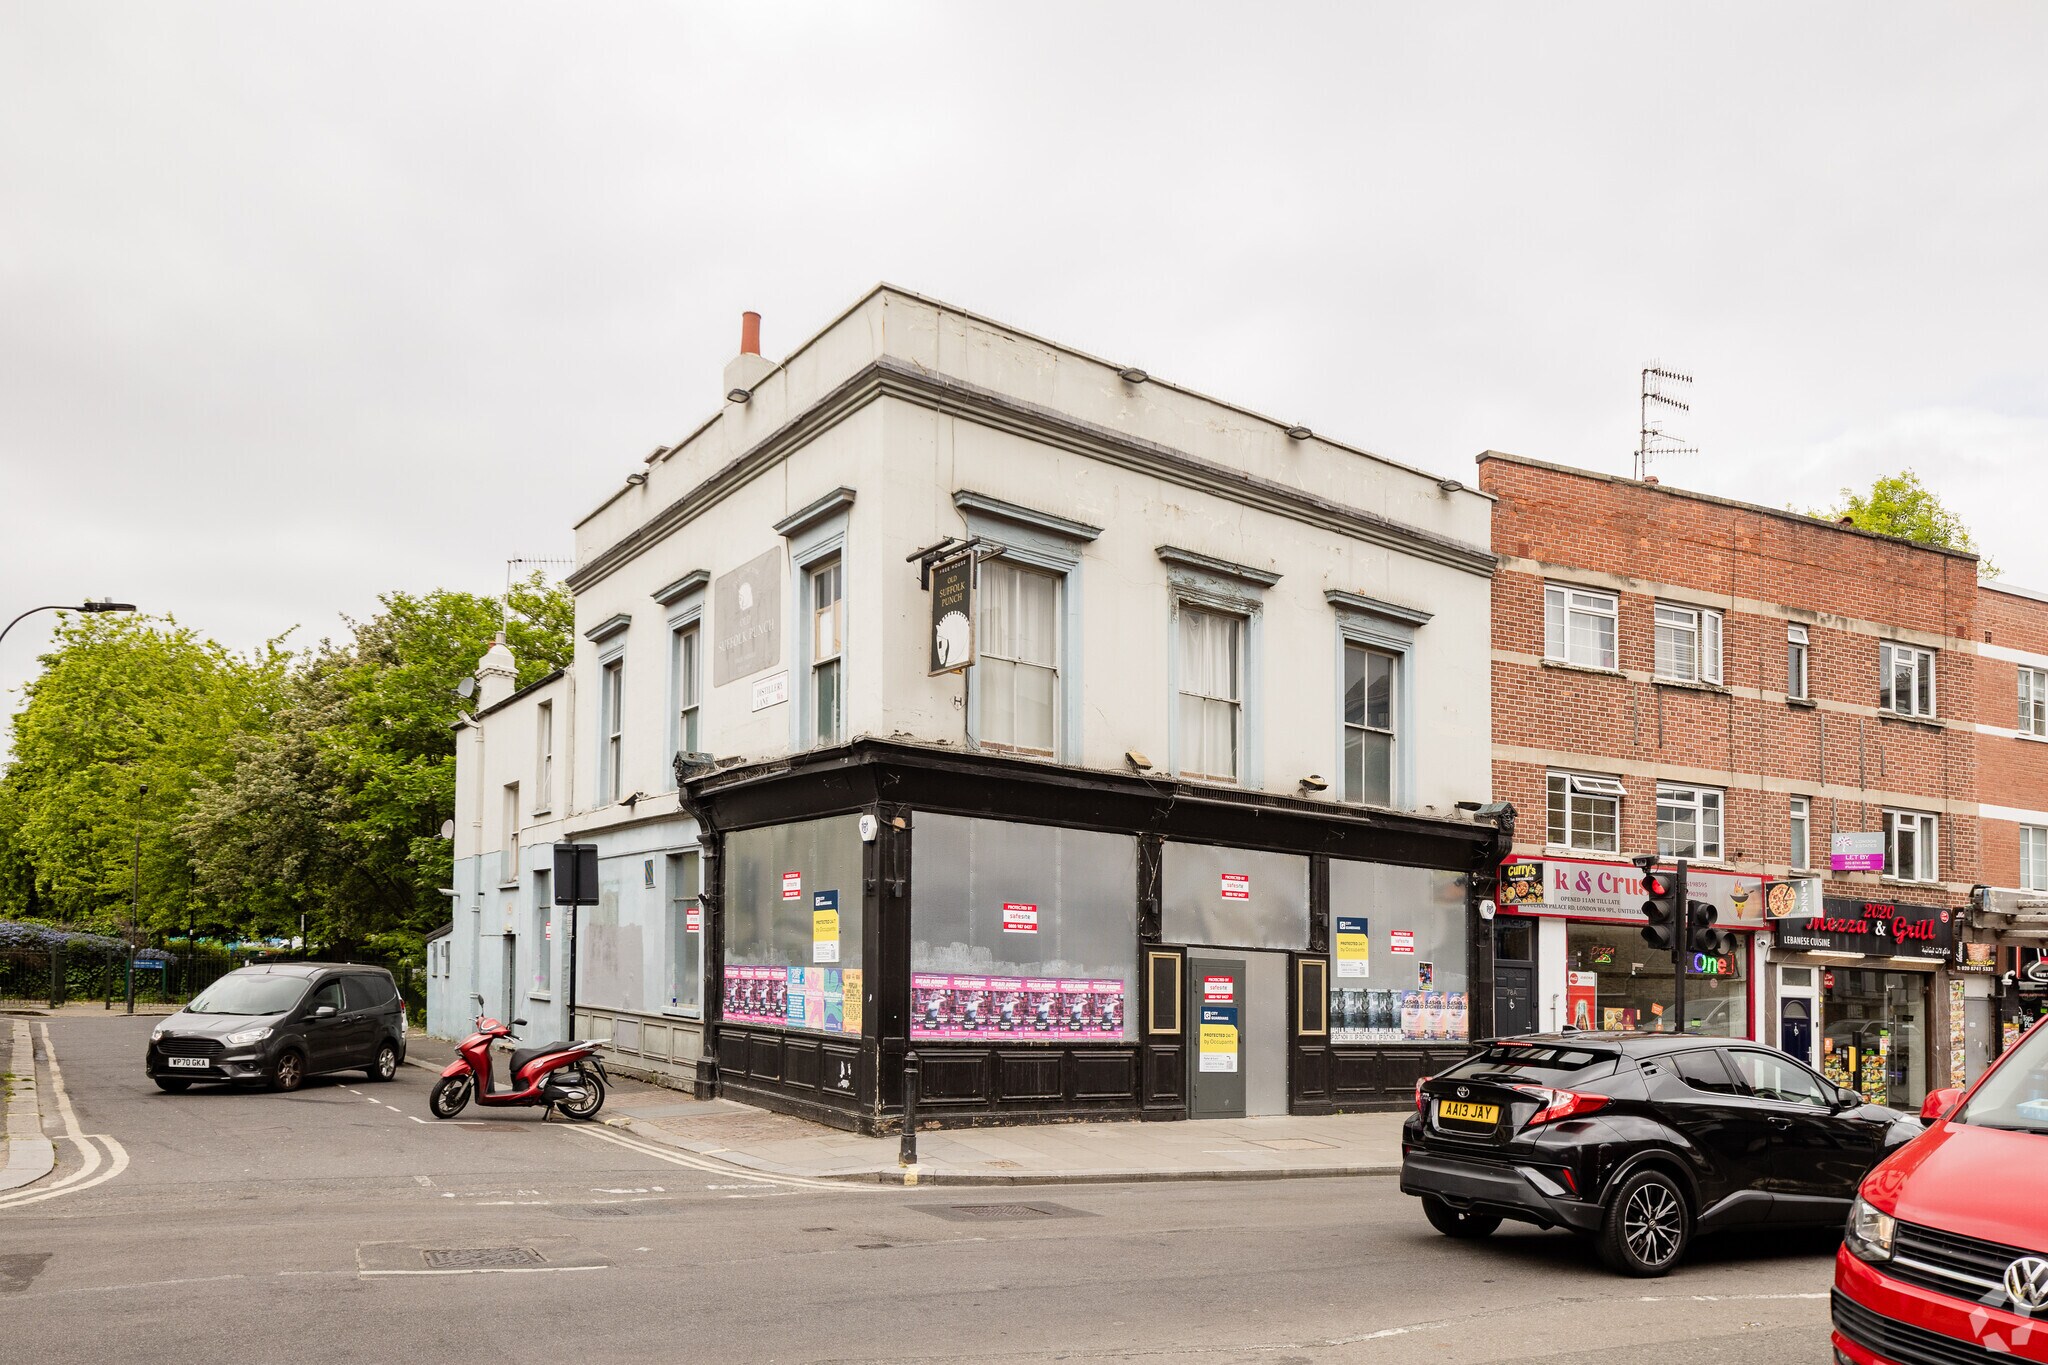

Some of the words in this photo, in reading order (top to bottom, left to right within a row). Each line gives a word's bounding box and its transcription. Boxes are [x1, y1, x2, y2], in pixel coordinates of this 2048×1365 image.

[947, 575, 958, 584] OLD
[939, 581, 965, 598] SUFFOLK
[941, 593, 962, 608] PUNCH
[749, 618, 774, 640] PUNCH
[1508, 863, 1536, 878] Curry's
[1597, 872, 1650, 896] Crus
[1800, 880, 1809, 912] PIZZA
[1864, 903, 1895, 919] 2020
[1805, 910, 1868, 934] Mezza
[1874, 921, 1886, 936] &
[1892, 916, 1936, 944] Grill
[1784, 936, 1810, 946] LEBANESE
[1810, 937, 1831, 947] CUISINE
[1694, 952, 1727, 974] One
[1446, 1103, 1469, 1116] AA13
[1471, 1106, 1492, 1119] JAY
